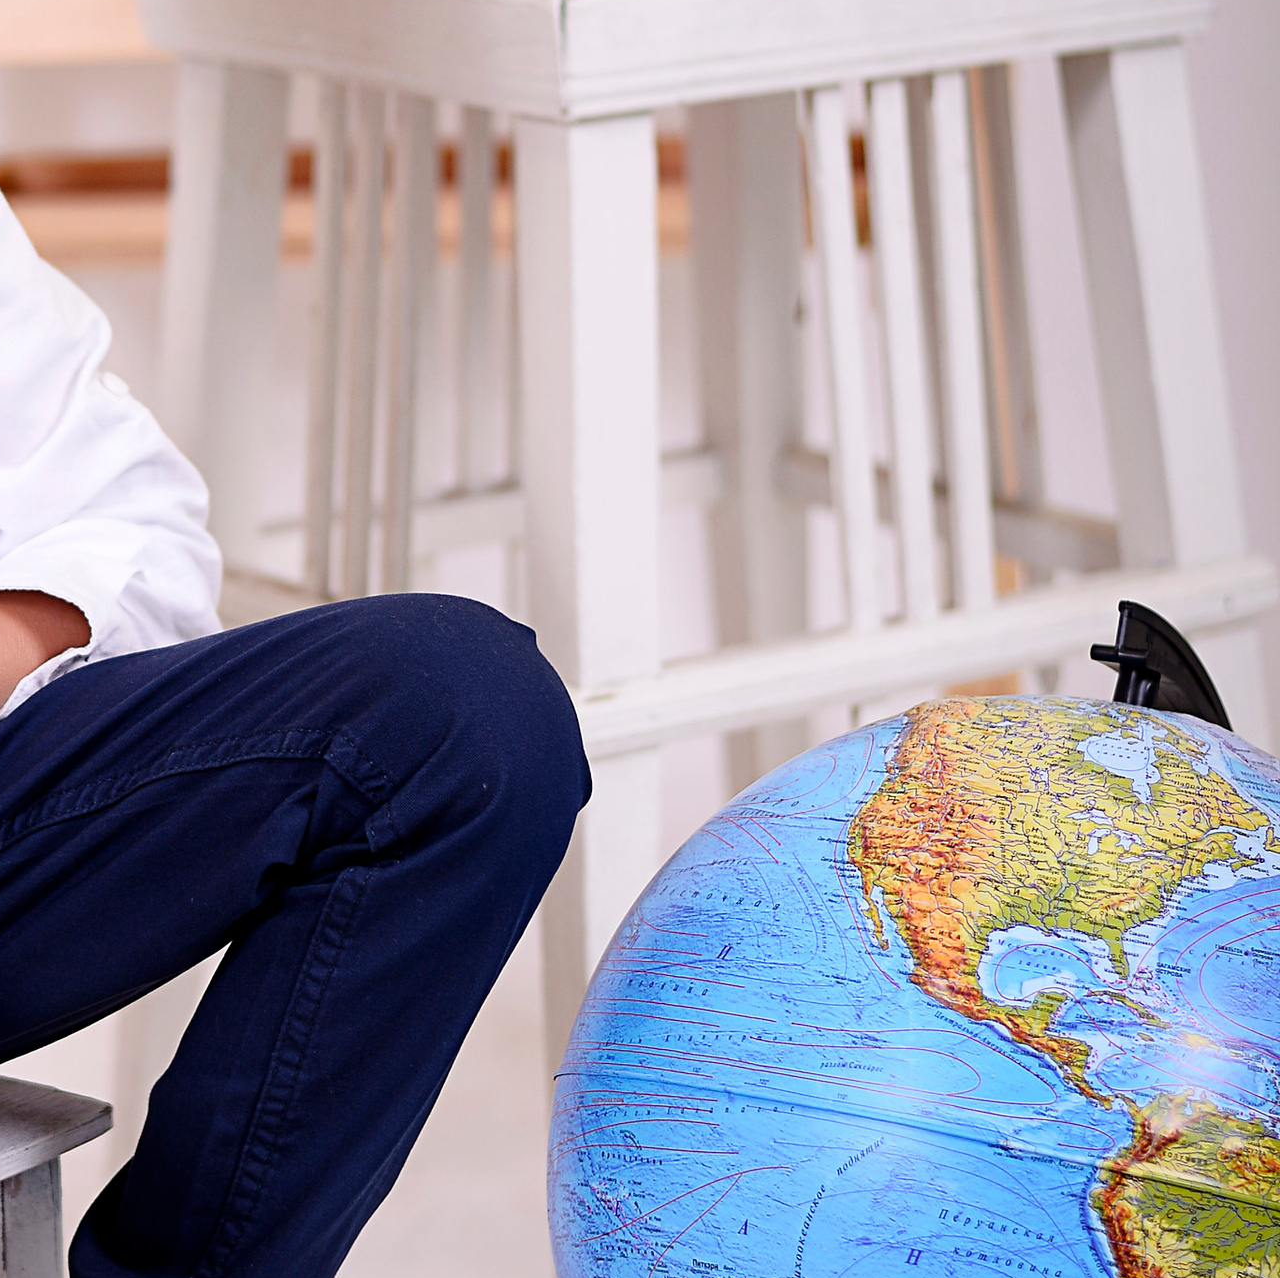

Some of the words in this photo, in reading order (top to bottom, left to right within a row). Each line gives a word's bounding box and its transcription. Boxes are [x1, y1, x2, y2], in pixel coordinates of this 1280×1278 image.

[836, 1137, 885, 1176] поднятие
[938, 1208, 1055, 1243] Перуанская
[952, 1246, 1063, 1278] котловина
